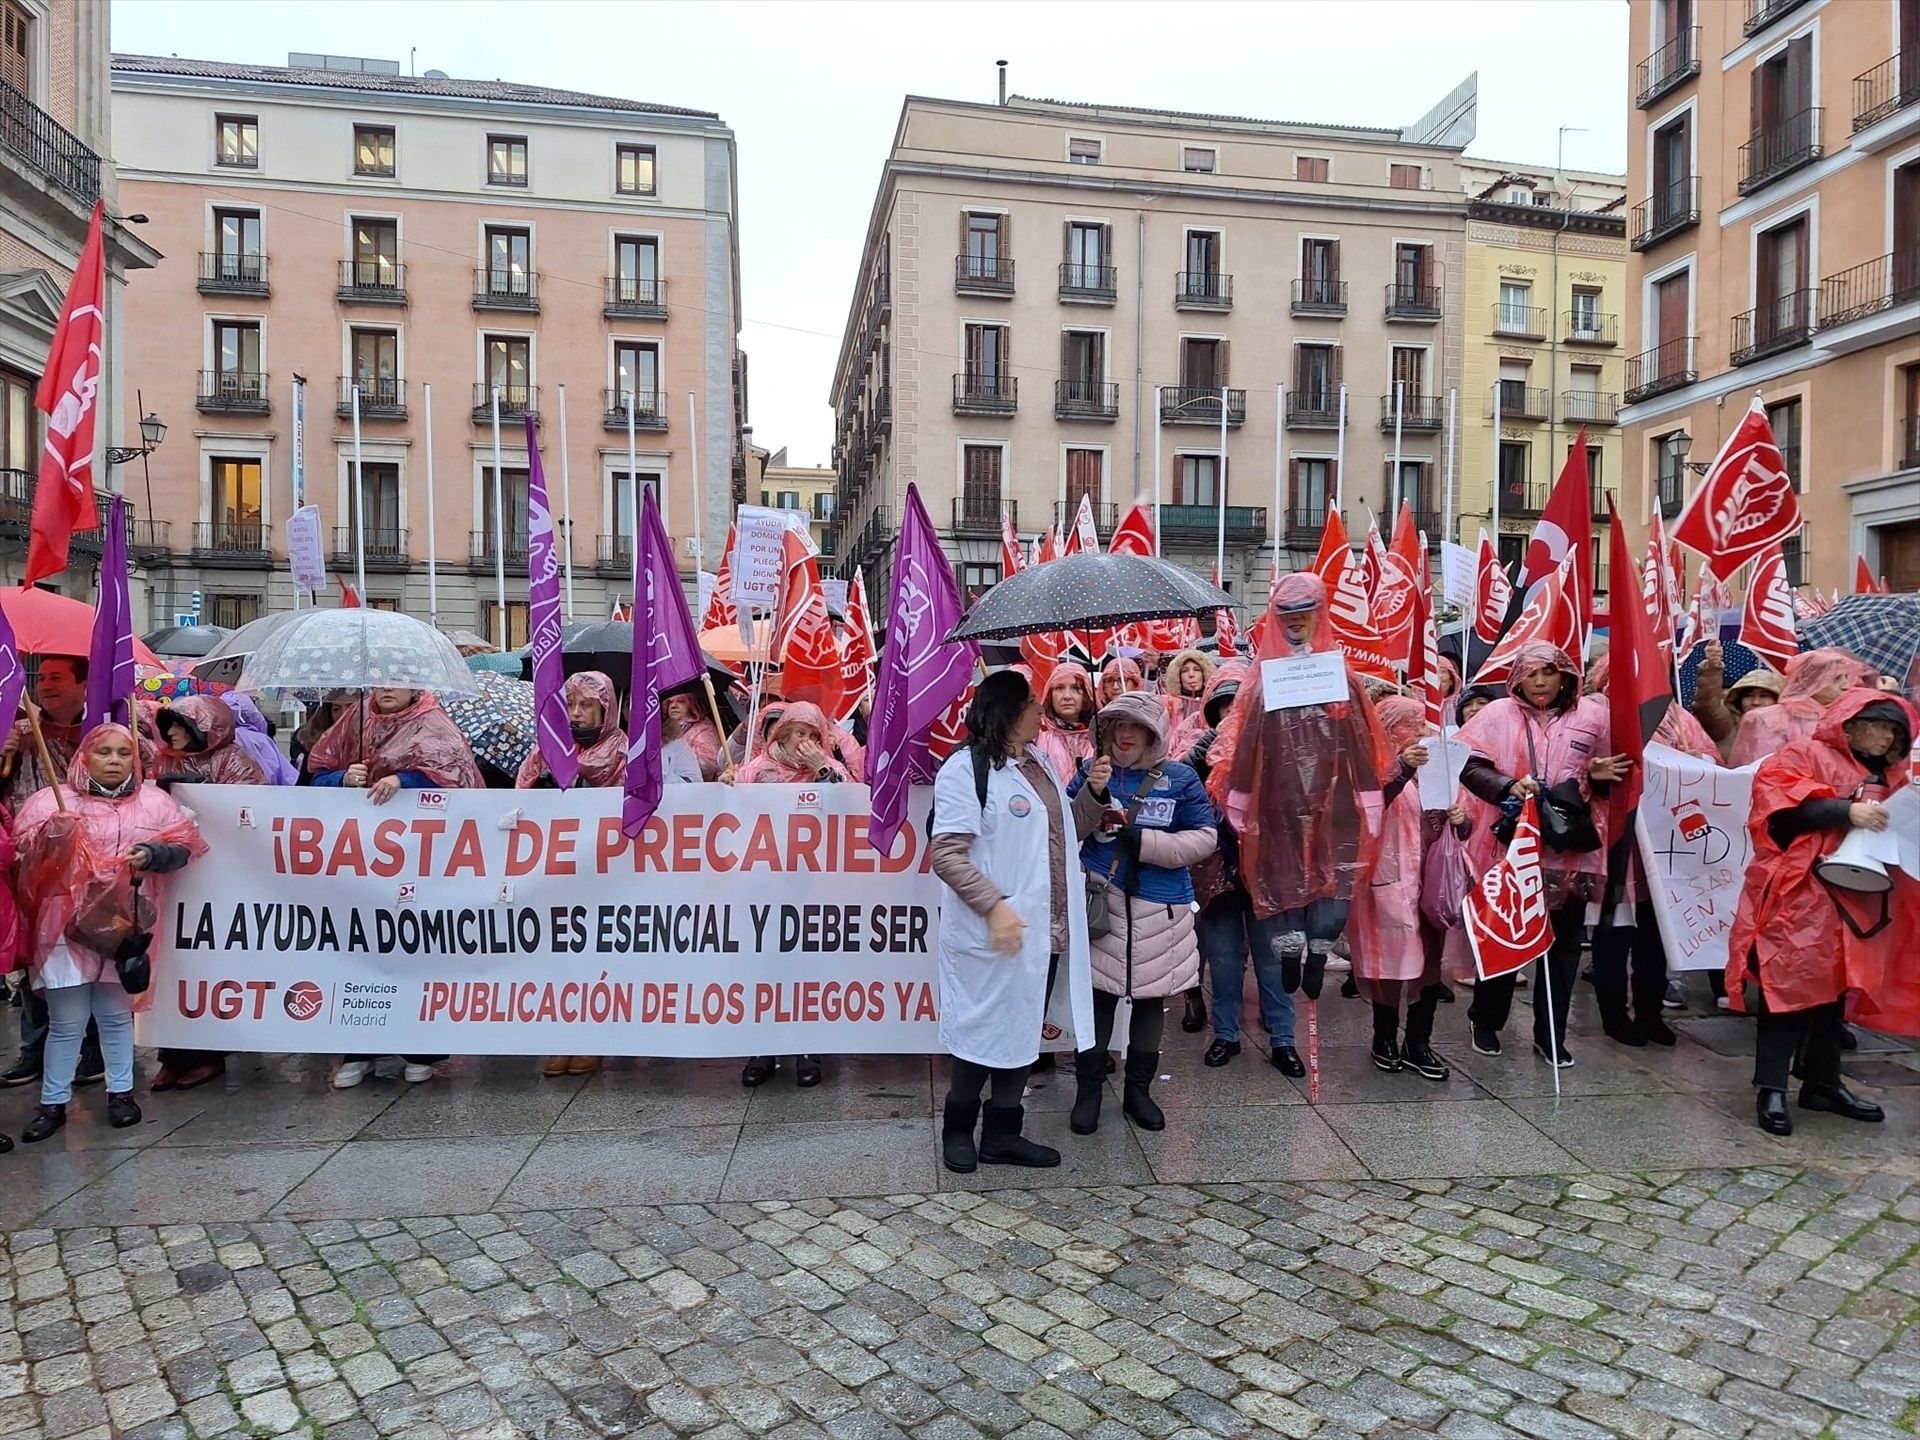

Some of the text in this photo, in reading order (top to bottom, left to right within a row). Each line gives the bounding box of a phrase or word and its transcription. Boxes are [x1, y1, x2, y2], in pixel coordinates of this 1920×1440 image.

[751, 531, 784, 541] DOMICIL
[750, 544, 780, 553] POR UN
[743, 581, 766, 592] UGT
[1684, 824, 1710, 841] CGT
[271, 816, 487, 878] ¡BASTA
[504, 817, 580, 877] DE
[1506, 836, 1546, 924] UGT
[1683, 898, 1715, 928] EN
[175, 902, 216, 951] LA
[225, 903, 340, 952] AYUDA
[347, 906, 369, 953] A
[375, 907, 541, 956] DOMICILIO
[551, 905, 588, 954] ES
[596, 903, 739, 953] ESENCIAL
[749, 904, 772, 953] Y
[779, 903, 862, 953] DEBE
[869, 903, 929, 953] SER
[343, 982, 398, 994] Servicios
[177, 979, 277, 1021] UGT
[342, 996, 392, 1011] Públicos
[419, 971, 938, 1025] ¡PUBLICACIÓN DE LOS PLIEGOS YA
[340, 1012, 387, 1027] Madrid
